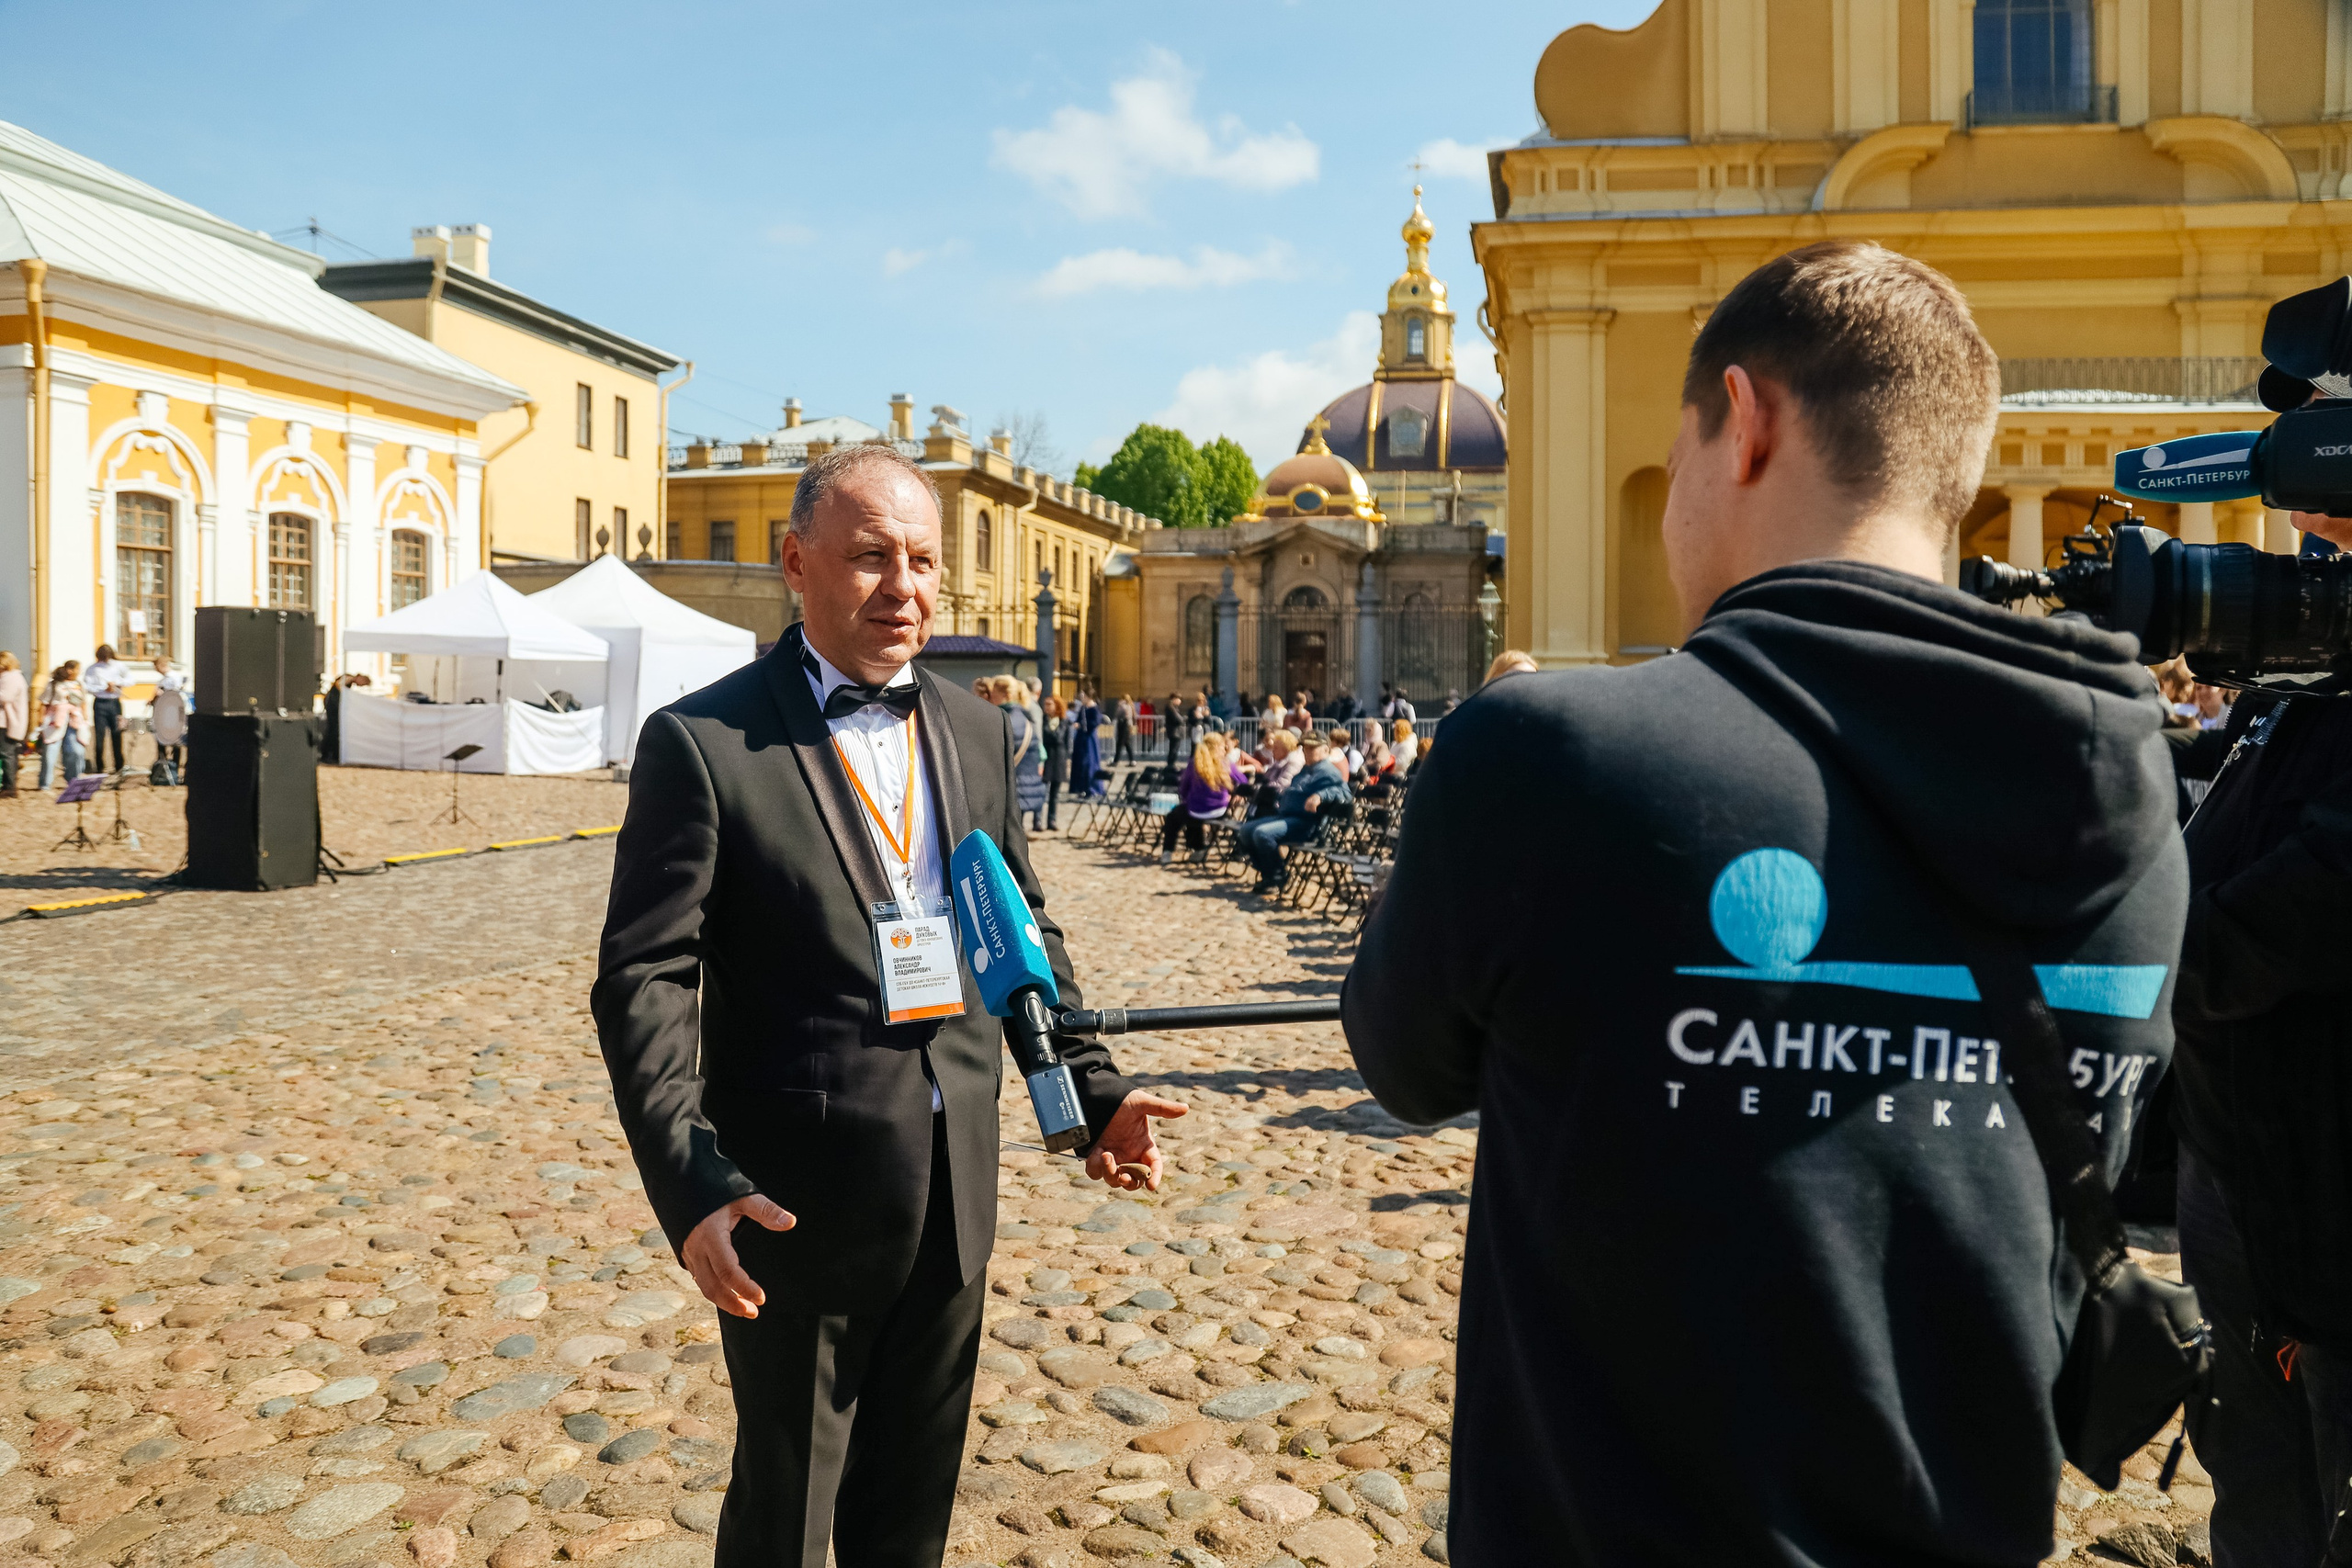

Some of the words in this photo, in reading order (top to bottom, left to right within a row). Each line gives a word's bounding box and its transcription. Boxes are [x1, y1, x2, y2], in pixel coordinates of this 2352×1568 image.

[2313, 445, 2352, 457] XDCA
[2138, 469, 2251, 490] САНКТ-ПЕТЕРБУР
[972, 859, 1006, 959] САНКТ-ПЕТЕРБУРГ
[893, 955, 922, 964] ОВЧИННИКОВ
[895, 966, 931, 976] ВЛАДИМИРОВИЧ
[1666, 1008, 2157, 1099] САНКТ-ПЕТБУРГ
[1059, 1084, 1075, 1120] SENNHEISER
